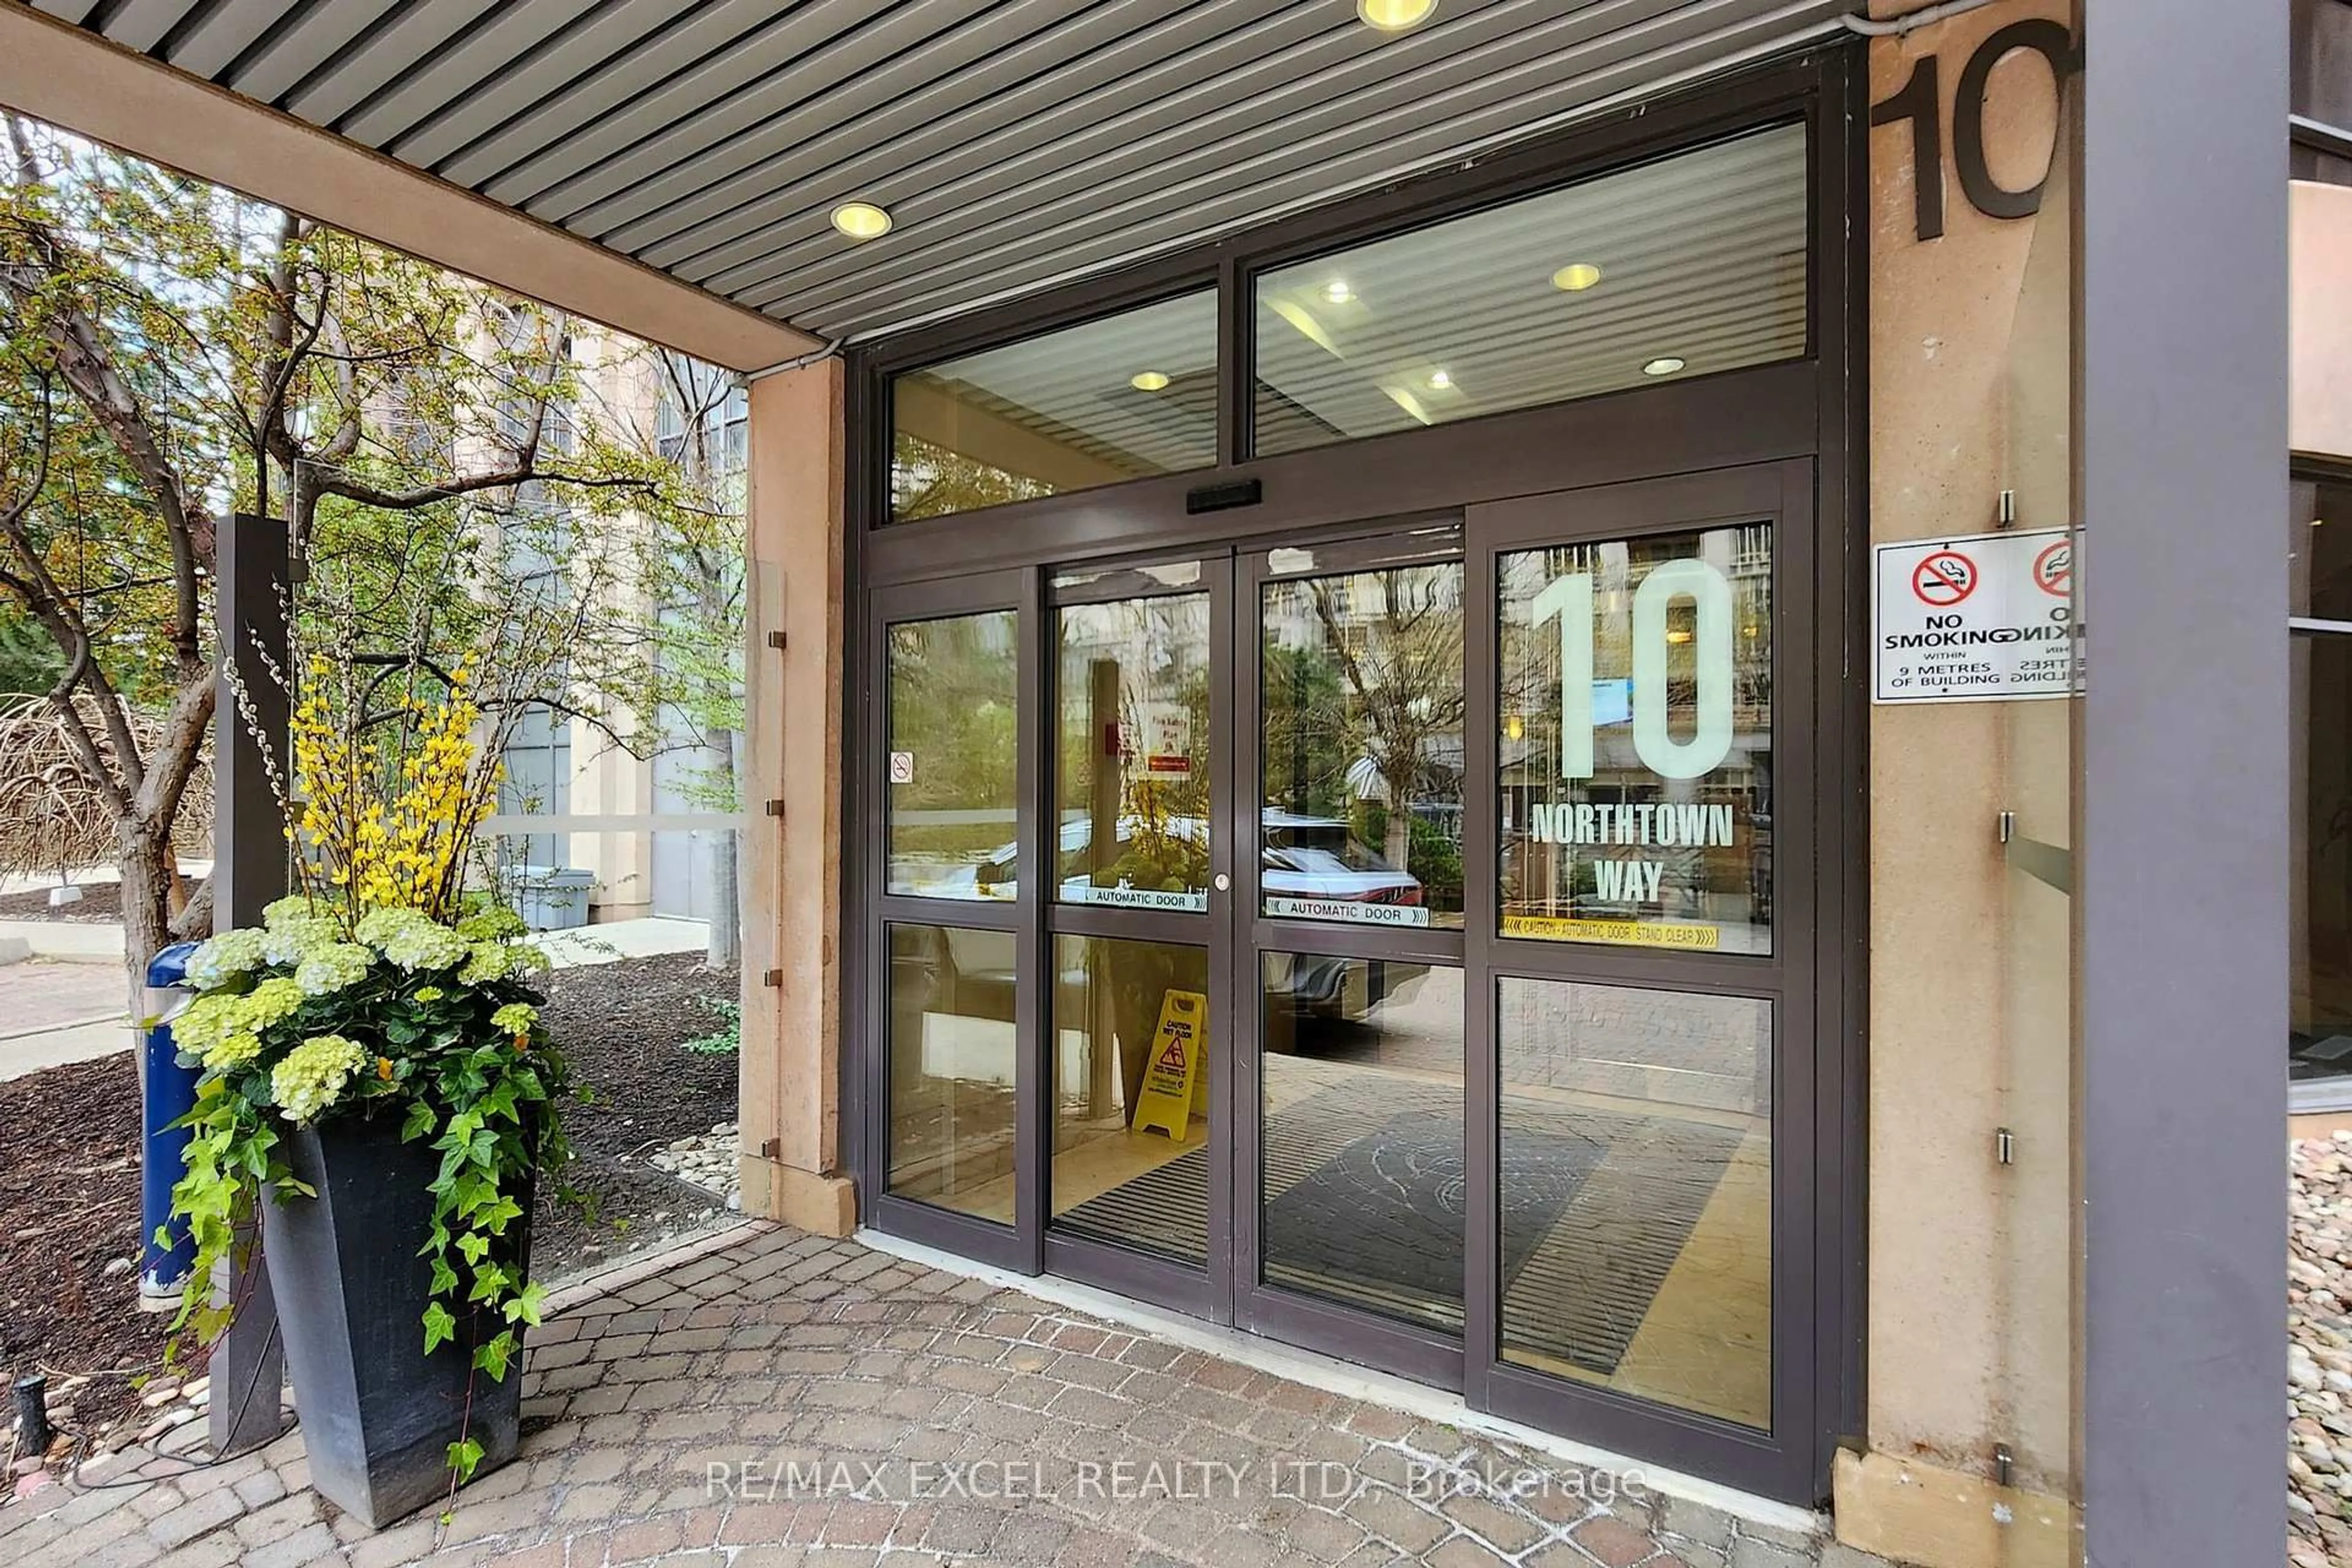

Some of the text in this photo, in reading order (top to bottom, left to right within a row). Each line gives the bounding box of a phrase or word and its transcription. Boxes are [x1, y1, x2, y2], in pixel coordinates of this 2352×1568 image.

[1871, 18, 2073, 242] 10
[1926, 614, 1962, 629] NO
[1885, 628, 2006, 649] SMOKING
[1531, 558, 1733, 780] 10
[1899, 663, 1991, 676] 9 METRES
[1891, 674, 2000, 687] OF BUILDING
[1532, 804, 1733, 846] NORTHTOWN
[1595, 861, 1664, 902] WAY
[1096, 891, 1186, 907] AUTOMATIC DOOR
[1291, 901, 1401, 920] AUTOMATIC DOOR
